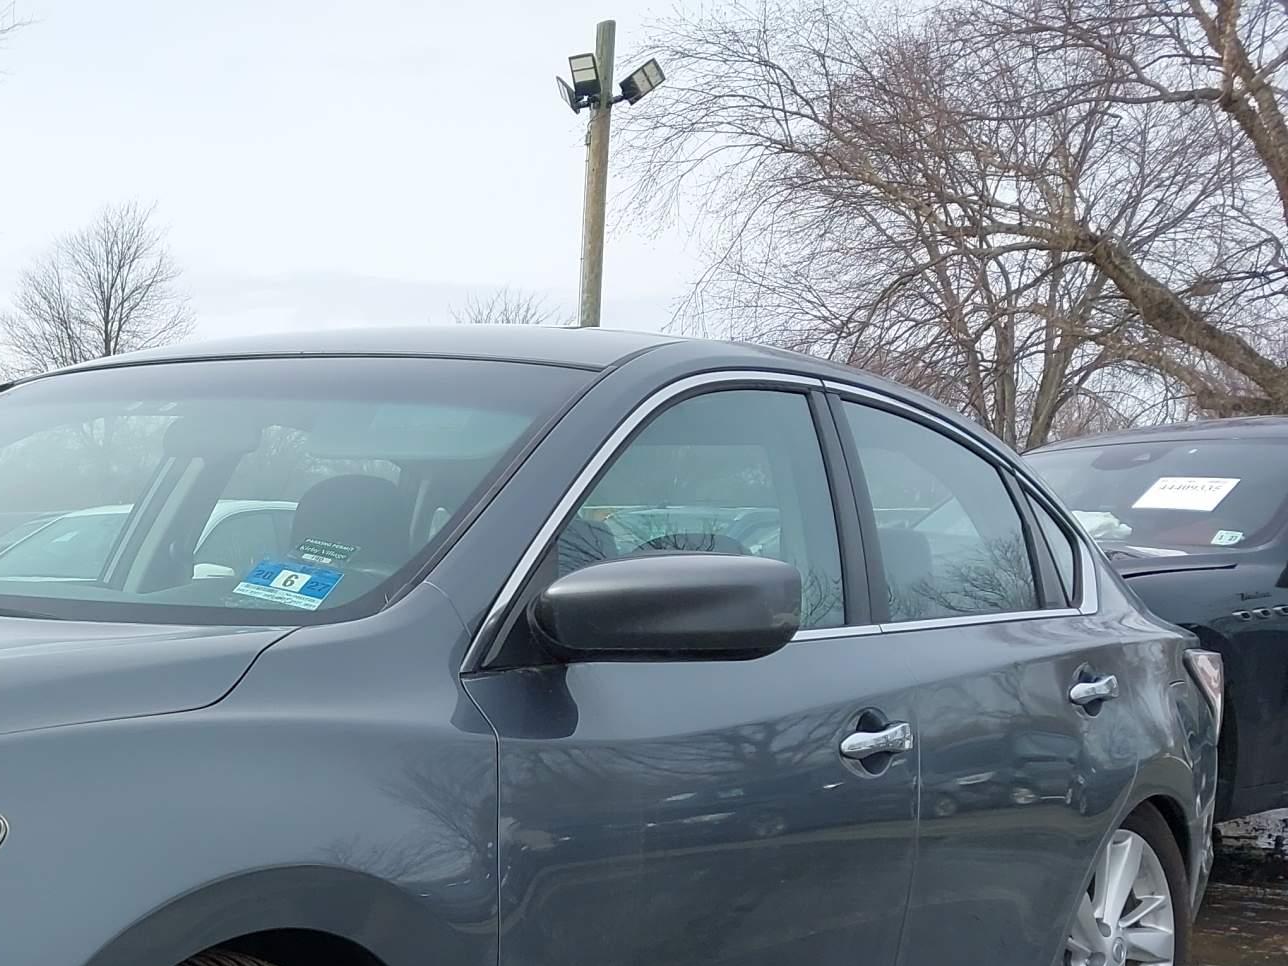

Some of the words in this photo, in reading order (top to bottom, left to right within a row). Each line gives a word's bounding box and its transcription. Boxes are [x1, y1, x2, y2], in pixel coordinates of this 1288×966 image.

[305, 538, 331, 547] PARKING
[332, 543, 355, 552] PERMIT
[321, 549, 347, 559] Village
[255, 568, 273, 580] 20
[282, 573, 299, 588] 6
[308, 581, 330, 592] 27
